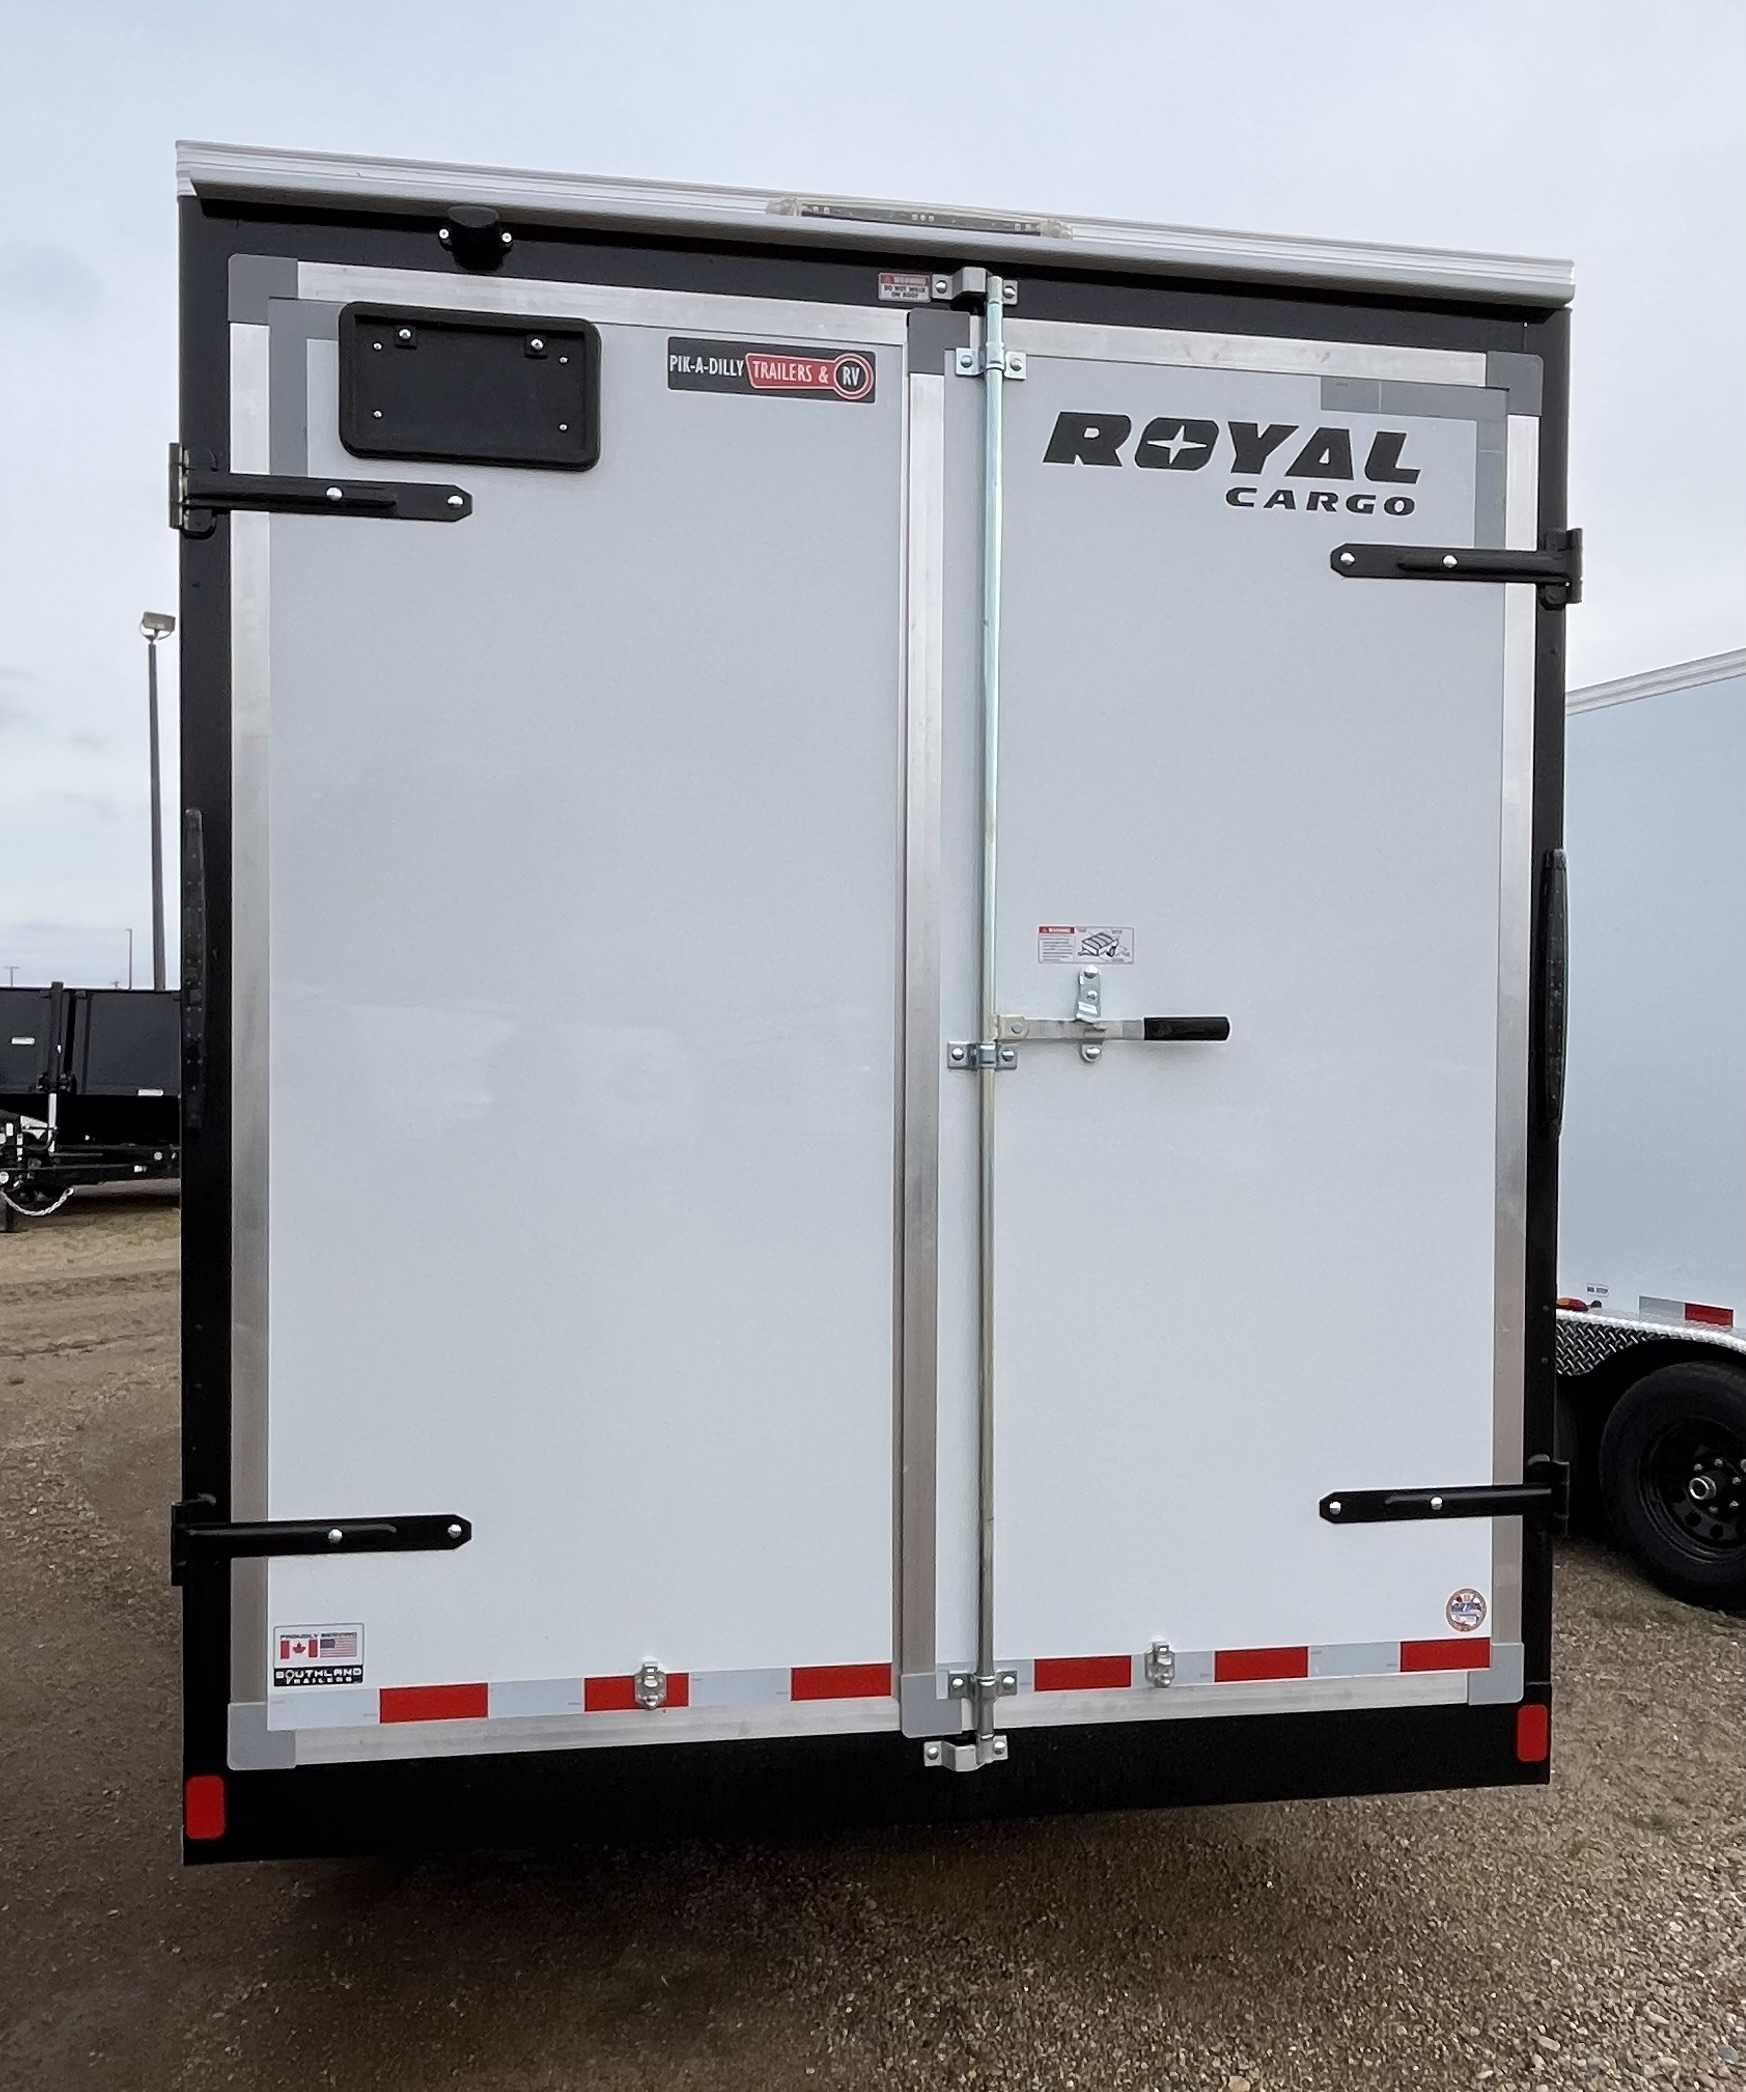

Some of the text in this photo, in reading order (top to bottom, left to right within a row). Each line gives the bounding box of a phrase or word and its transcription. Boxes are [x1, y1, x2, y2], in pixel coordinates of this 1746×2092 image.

[669, 355, 861, 386] PIK-A-DILLY TRAILERS & RV
[1042, 411, 1422, 484] ROYAL
[1225, 487, 1416, 516] CARGO
[275, 1667, 362, 1680] SOUTHLAND
